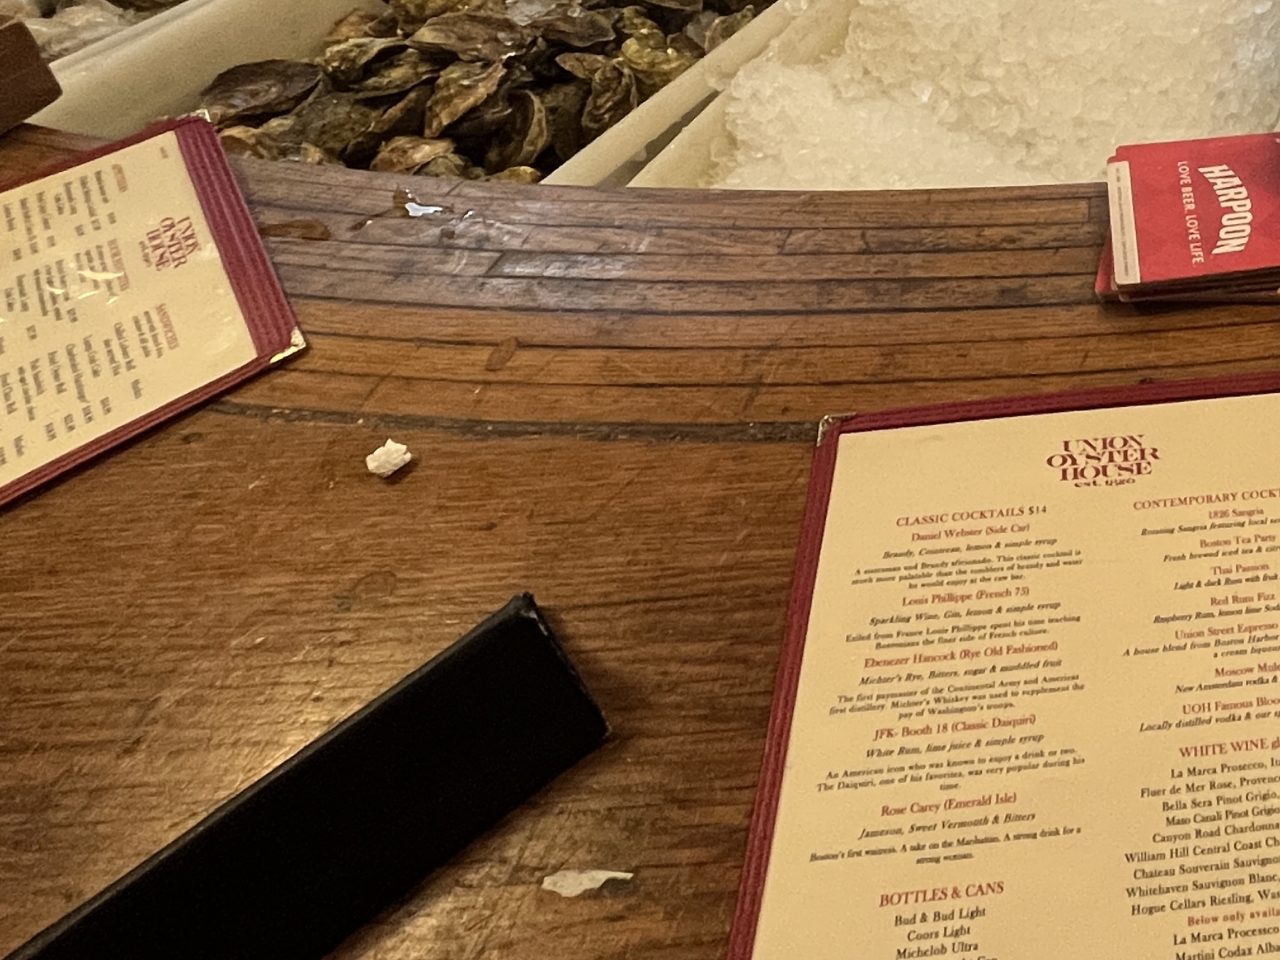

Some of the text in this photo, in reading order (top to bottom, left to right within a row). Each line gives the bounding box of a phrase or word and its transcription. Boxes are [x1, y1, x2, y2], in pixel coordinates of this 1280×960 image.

[1177, 160, 1192, 186] LOVE
[1185, 214, 1200, 241] LOVE
[1198, 164, 1253, 255] HARPOON
[160, 216, 188, 270] OYSTER
[176, 216, 200, 257] UNION
[146, 228, 164, 272] HOUSE
[1062, 434, 1144, 452] UNION
[1046, 446, 1160, 467] OYSTER
[1059, 461, 1153, 481] HOUSE
[1133, 493, 1238, 510] CONTEMPORARY
[896, 506, 1047, 526] CLASSIC COCKTAILS $14
[911, 531, 942, 542] Daniel
[944, 529, 982, 538] Webster
[1200, 534, 1276, 548] Boston Tea Party
[1211, 566, 1233, 575] Thai
[902, 587, 1030, 606] Louis Phillippe (French 75)
[1210, 592, 1276, 606] Red Rum Fizz
[1174, 630, 1204, 640] Union
[1207, 627, 1234, 636] Street
[864, 642, 1058, 668] Ebenezer Hancock (Rye Old Fashioned)
[1214, 667, 1254, 677] Moscow
[1182, 702, 1212, 715] UOH
[1214, 700, 1253, 712] Famous
[901, 724, 932, 737] Booth
[936, 723, 948, 734] 18
[951, 720, 988, 732] (Classic
[992, 714, 1036, 729] Daiquiri)
[1179, 743, 1228, 758] WHITE
[1230, 738, 1270, 752] WINE
[881, 792, 1017, 816] Rose Carey (Emerald Isle)
[1125, 851, 1166, 863] William
[1170, 846, 1189, 859] Hill
[1192, 842, 1230, 856] Central
[1234, 840, 1262, 851] Coast
[1134, 867, 1175, 880] Chateau
[1179, 861, 1230, 875] Souverain
[879, 882, 1004, 907] BOTTLES & CANS
[1126, 883, 1188, 898] Whitehaven
[1192, 877, 1244, 892] Sauvignon
[1248, 872, 1280, 884] Blanc,
[894, 906, 986, 927] Bud & Bud Light
[1131, 904, 1166, 916] Hogue
[1170, 898, 1206, 911] Cellars
[907, 925, 970, 942] Coors Light
[1173, 934, 1186, 946] La
[1190, 932, 1223, 944] Marca
[896, 942, 979, 960] Michelob Ultra
